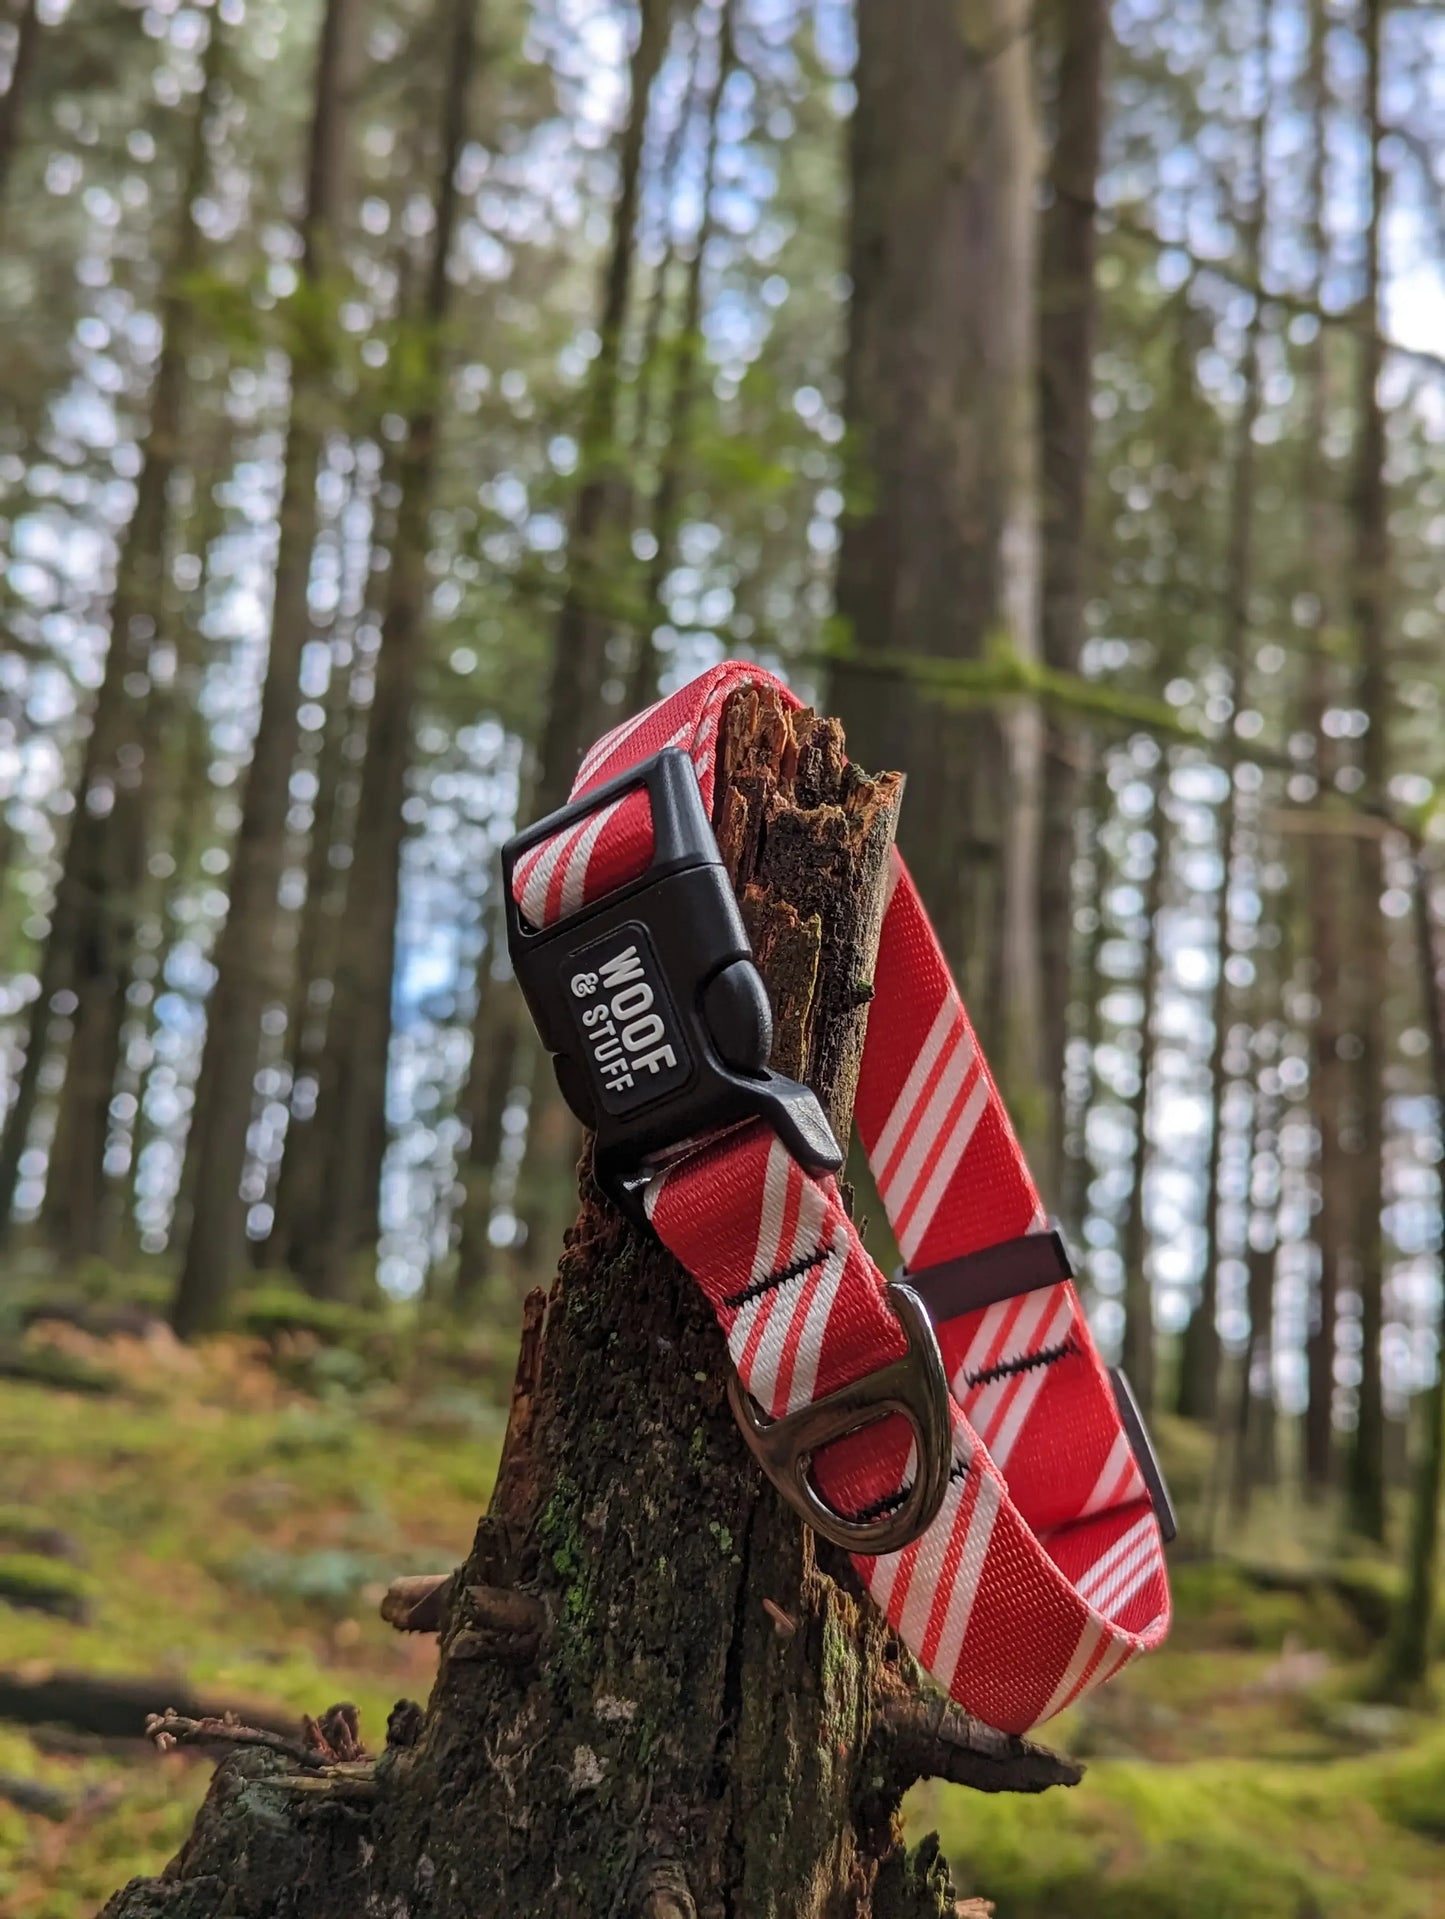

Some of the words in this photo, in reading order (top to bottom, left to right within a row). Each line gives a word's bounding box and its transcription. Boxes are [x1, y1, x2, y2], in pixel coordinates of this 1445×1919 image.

[570, 972, 599, 998] &
[598, 945, 677, 1074] WOOF
[582, 1003, 635, 1092] STUFF
